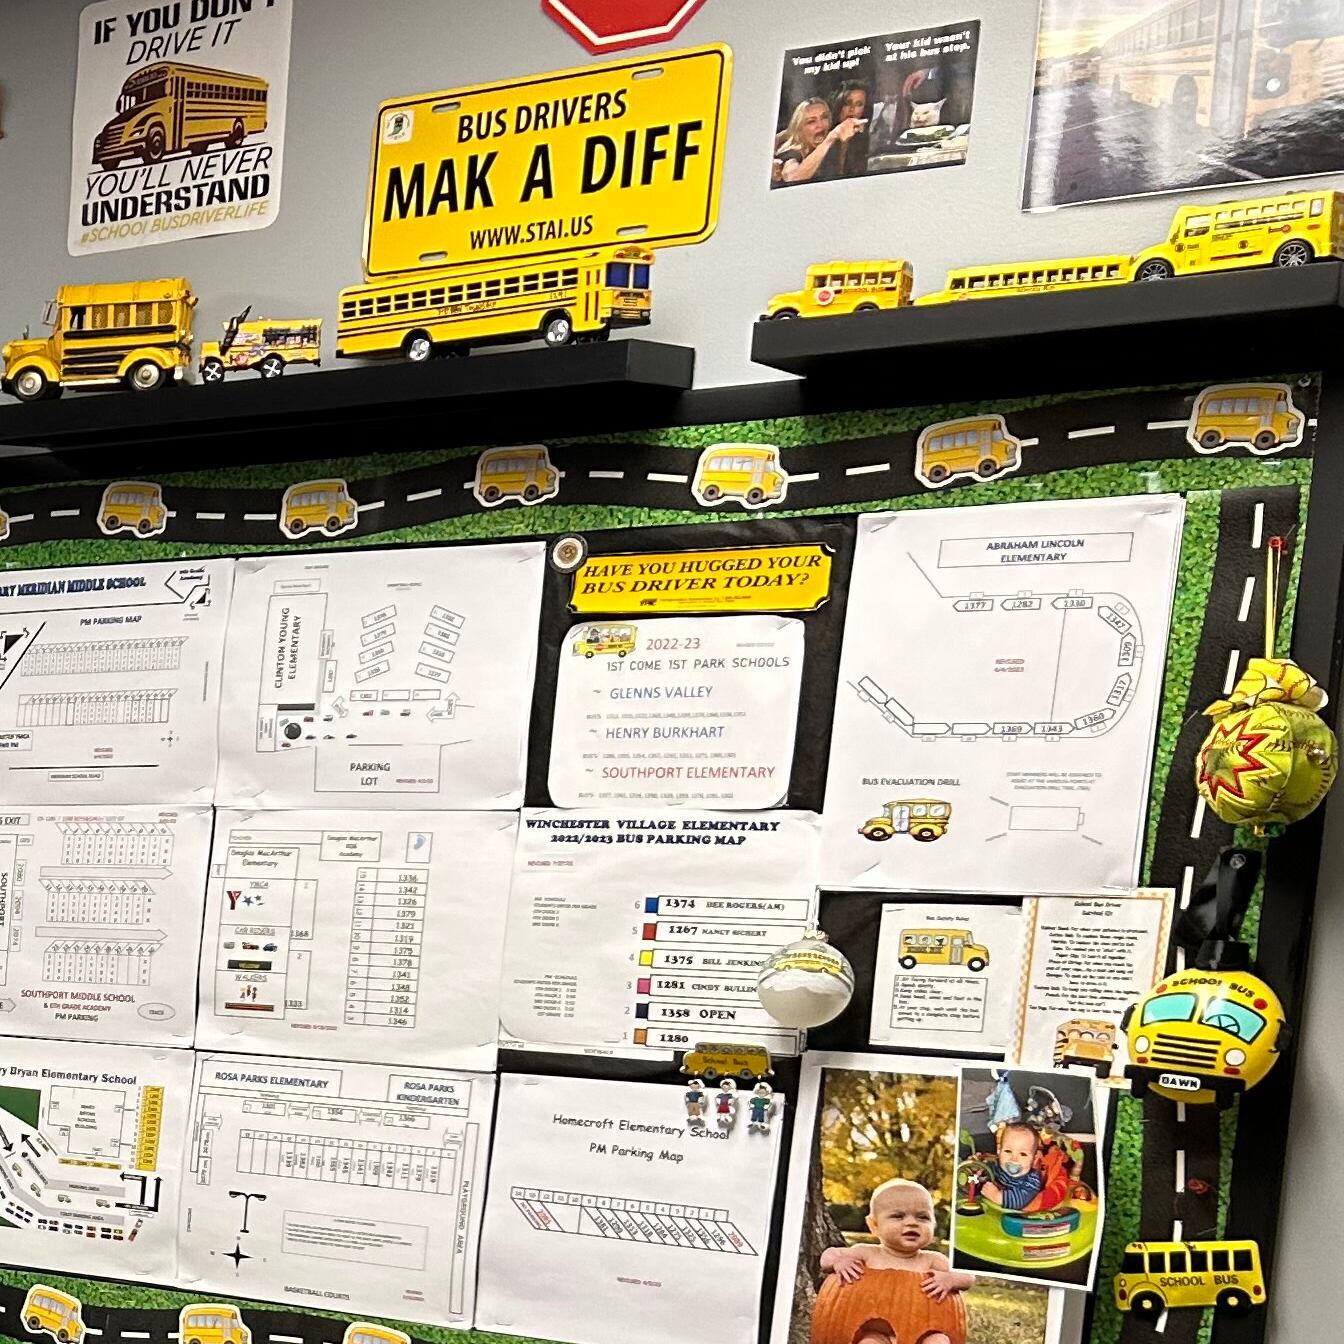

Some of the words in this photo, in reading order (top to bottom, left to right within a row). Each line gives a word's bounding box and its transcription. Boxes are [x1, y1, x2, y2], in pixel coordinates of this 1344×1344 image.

[94, 17, 117, 45] IF
[126, 2, 180, 37] YOU
[126, 25, 207, 65] DRIVE
[211, 18, 242, 47] IT
[885, 41, 912, 52] Your
[913, 37, 931, 47] kid
[933, 30, 971, 44] wasn't
[458, 108, 508, 144] BUS
[513, 89, 628, 136] DRIVERS
[86, 168, 173, 198] YOU'LL
[180, 146, 274, 183] NEVER
[382, 151, 498, 223] MAK
[520, 144, 554, 202] A
[580, 120, 703, 194] DIFF
[81, 173, 271, 226] UNDERSTAND
[470, 215, 594, 250] WWW.STAI.US
[583, 565, 633, 579] HAVE
[637, 562, 677, 576] YOU
[680, 558, 762, 574] HUGGED
[766, 555, 822, 569] YOUR
[581, 581, 625, 595] BUS
[629, 578, 716, 593] DRIVER
[724, 573, 810, 589] TODAY?
[646, 638, 700, 650] 2022-23
[610, 687, 662, 700] GLENNS
[665, 685, 713, 698] VALLEY
[602, 766, 683, 779] SOUTHPORT
[687, 765, 775, 779] ELEMENTARY
[526, 820, 610, 830] WINCHESTER
[616, 820, 676, 830] VILLAGE
[682, 821, 781, 832] ELEMENTARY
[699, 1010, 737, 1021] OPEN
[1161, 1076, 1200, 1089] DAWN
